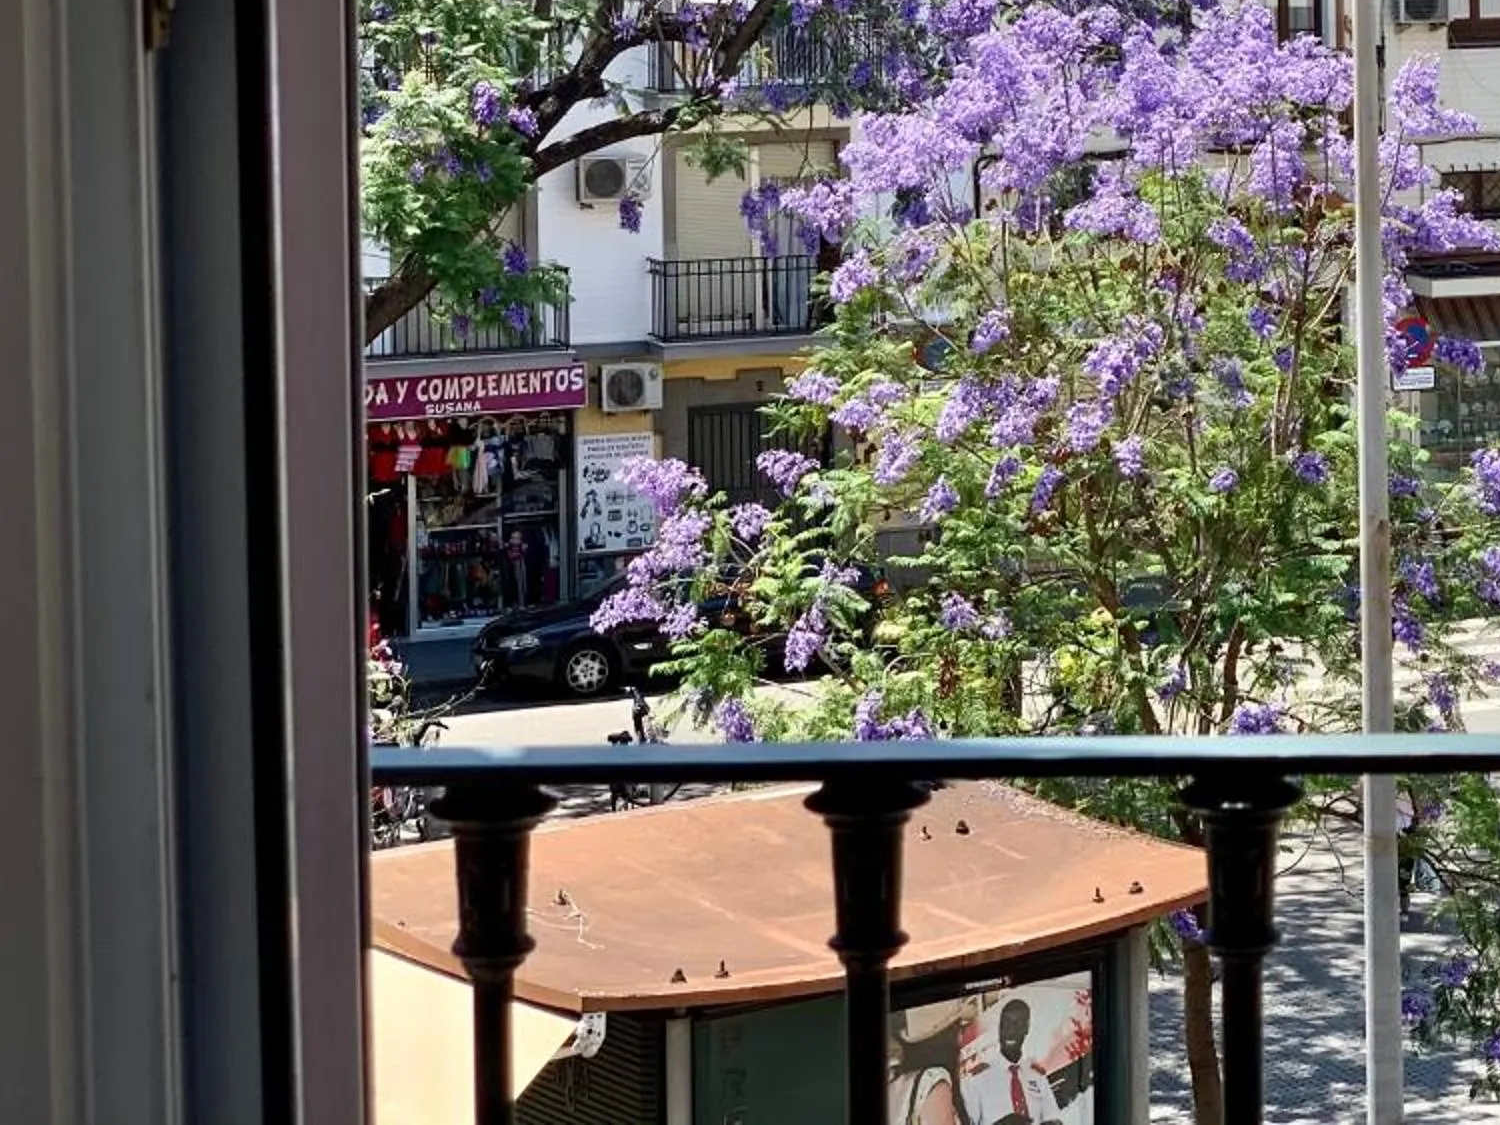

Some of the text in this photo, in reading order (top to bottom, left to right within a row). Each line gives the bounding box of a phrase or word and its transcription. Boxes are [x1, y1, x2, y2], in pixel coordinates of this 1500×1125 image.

[397, 380, 409, 404] Y
[416, 368, 584, 403] COMPLEMENTOS
[424, 401, 481, 415] SUSANA
